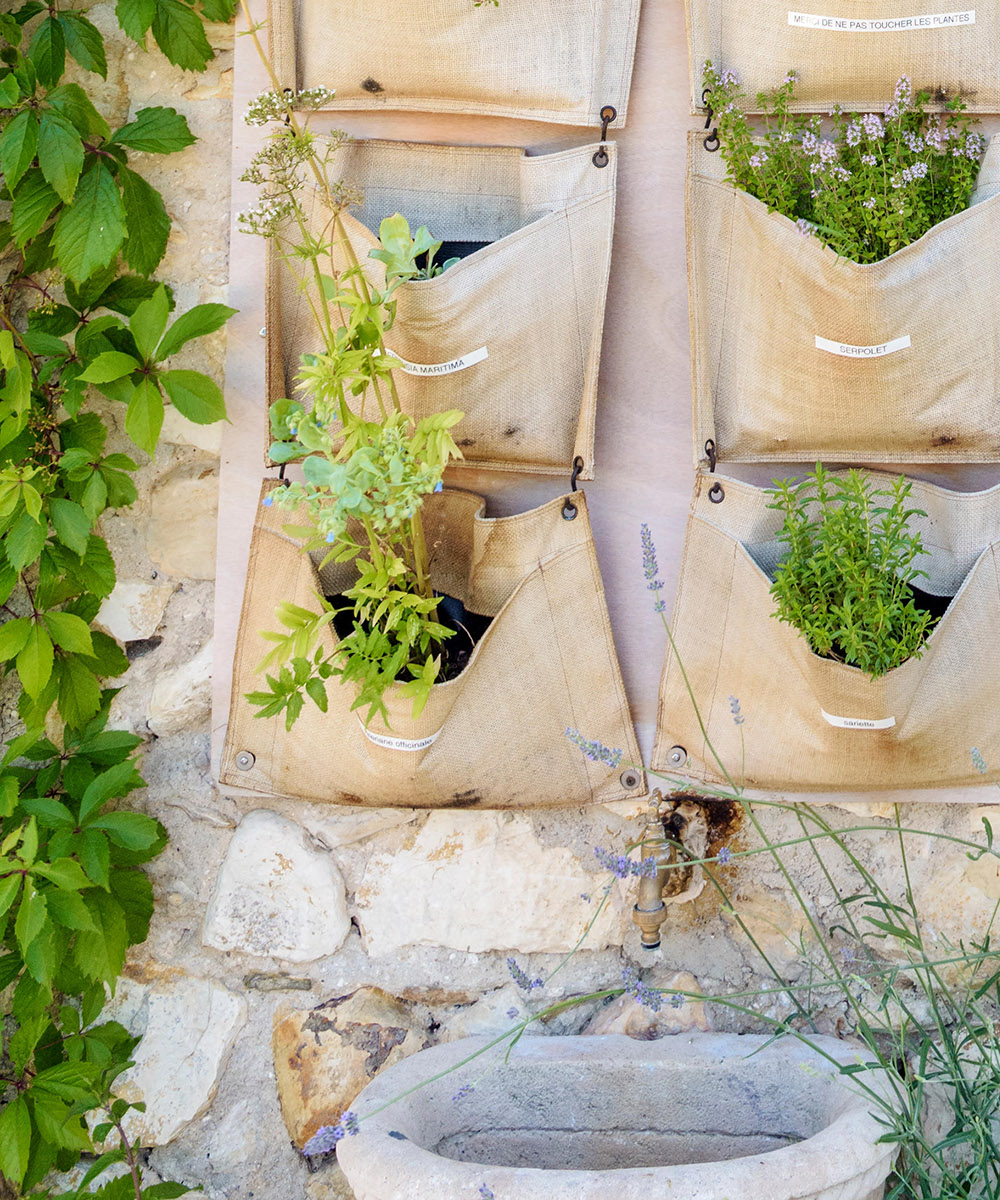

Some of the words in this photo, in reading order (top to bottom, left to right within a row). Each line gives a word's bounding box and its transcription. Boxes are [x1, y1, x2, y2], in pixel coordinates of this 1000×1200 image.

[822, 18, 833, 27] DE
[835, 19, 847, 28] NE
[850, 21, 867, 29] PAS
[870, 19, 913, 29] TOUCHER
[914, 17, 931, 27] LES
[933, 13, 970, 24] PLANTES
[839, 345, 888, 356] SERPOLET
[419, 359, 465, 374] MARITIMA
[844, 719, 875, 728] sariette
[395, 738, 433, 749] officinale
